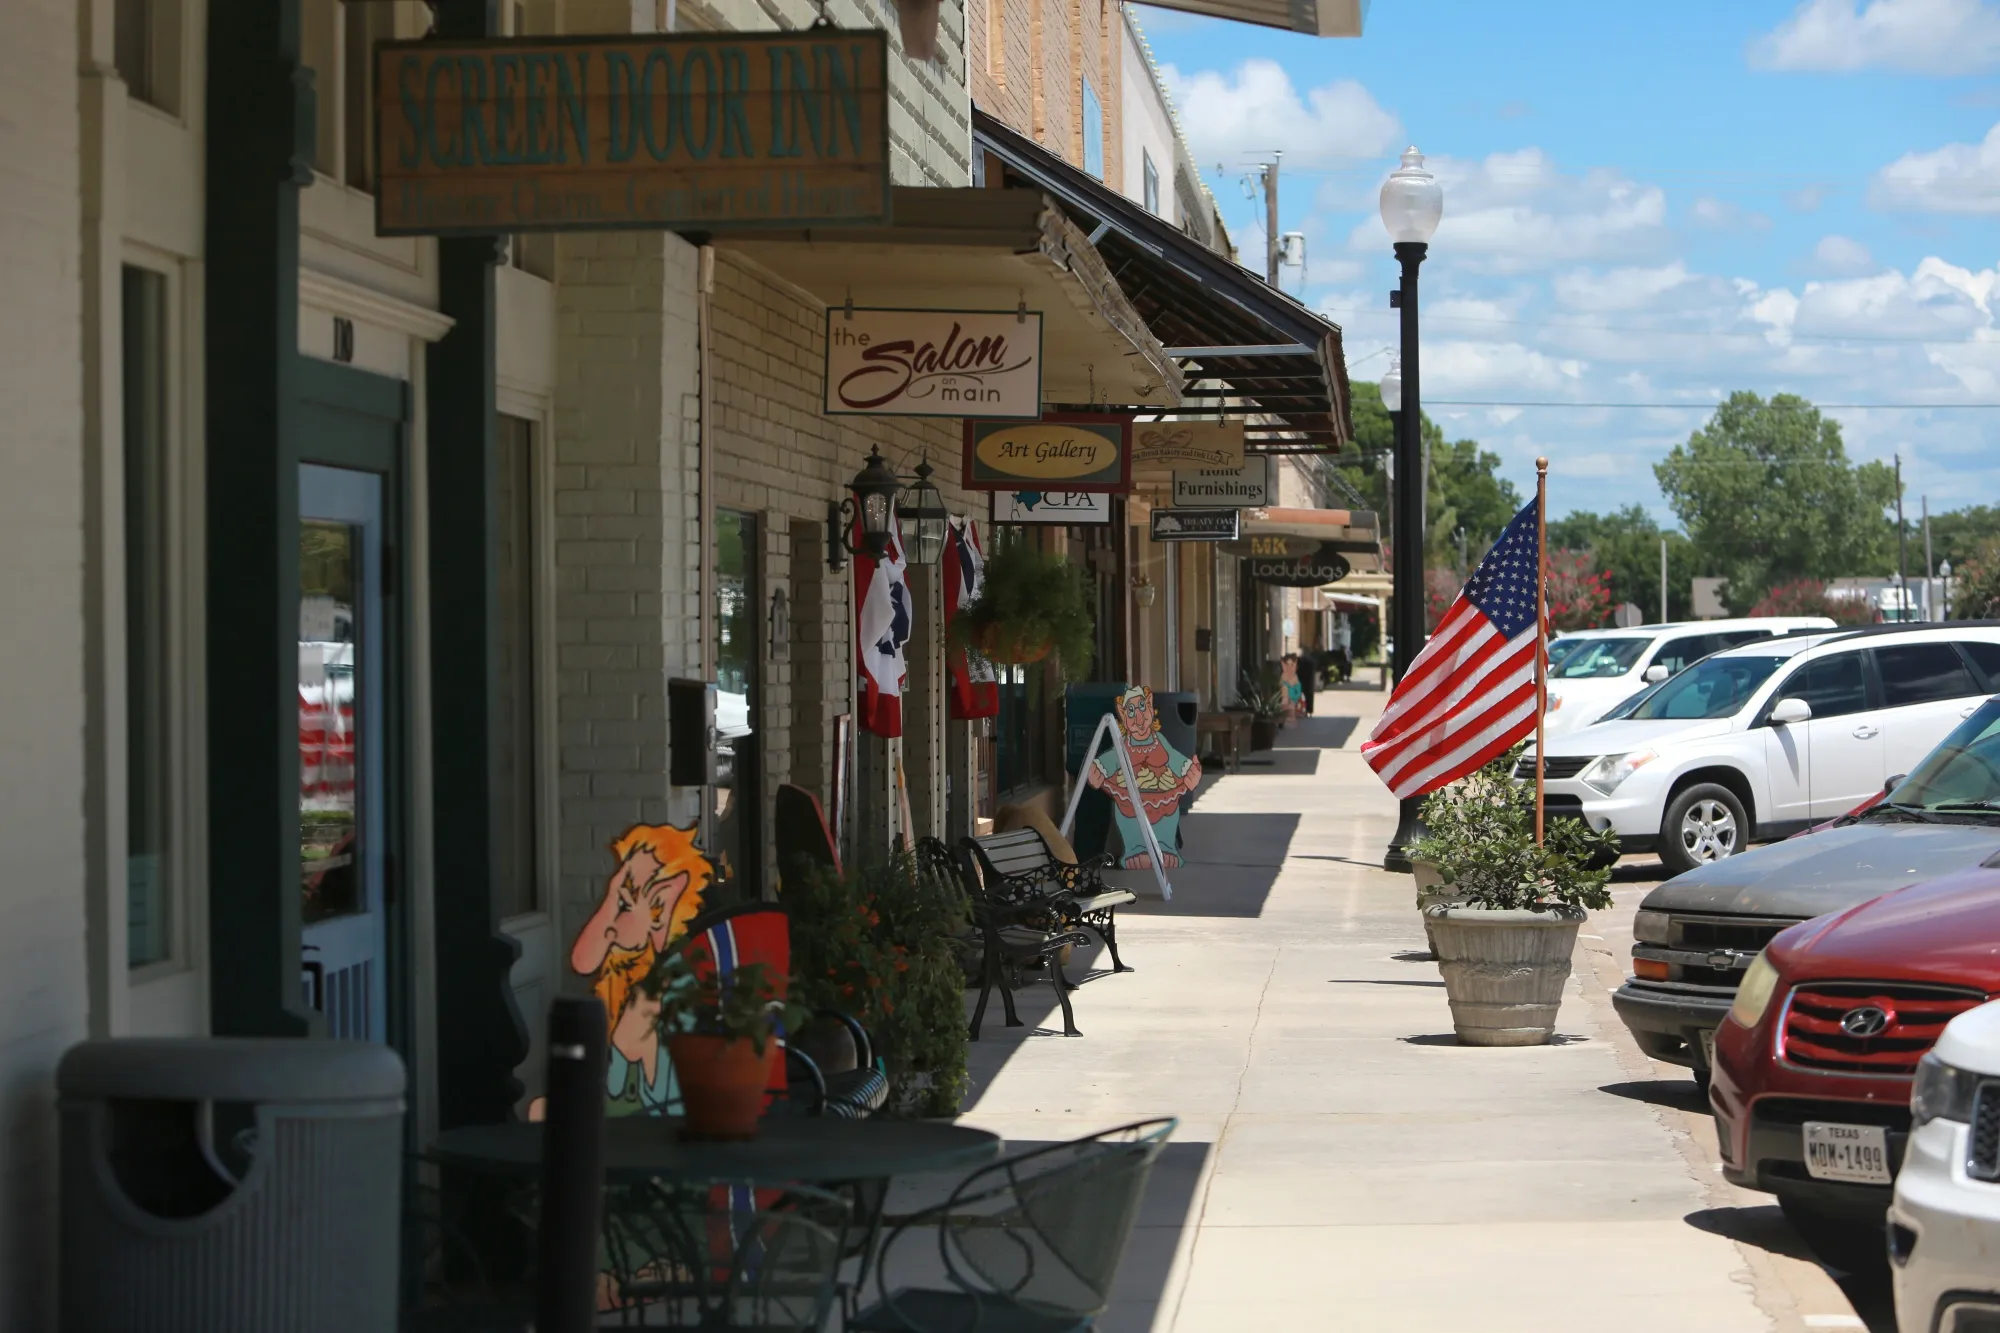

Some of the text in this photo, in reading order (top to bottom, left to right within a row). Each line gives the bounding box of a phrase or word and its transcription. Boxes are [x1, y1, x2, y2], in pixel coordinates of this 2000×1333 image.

[399, 45, 863, 169] SCREEN DOOR INN
[833, 326, 870, 347] the
[837, 321, 1010, 409] Salon
[942, 377, 957, 386] on
[942, 386, 1001, 403] main
[997, 439, 1098, 465] Art Gallery
[1042, 491, 1095, 507] CPA
[1177, 480, 1264, 499] Furnishings
[1251, 536, 1289, 556] MK
[1252, 560, 1344, 581] Ladybugs
[1828, 1126, 1860, 1140] TEXAS
